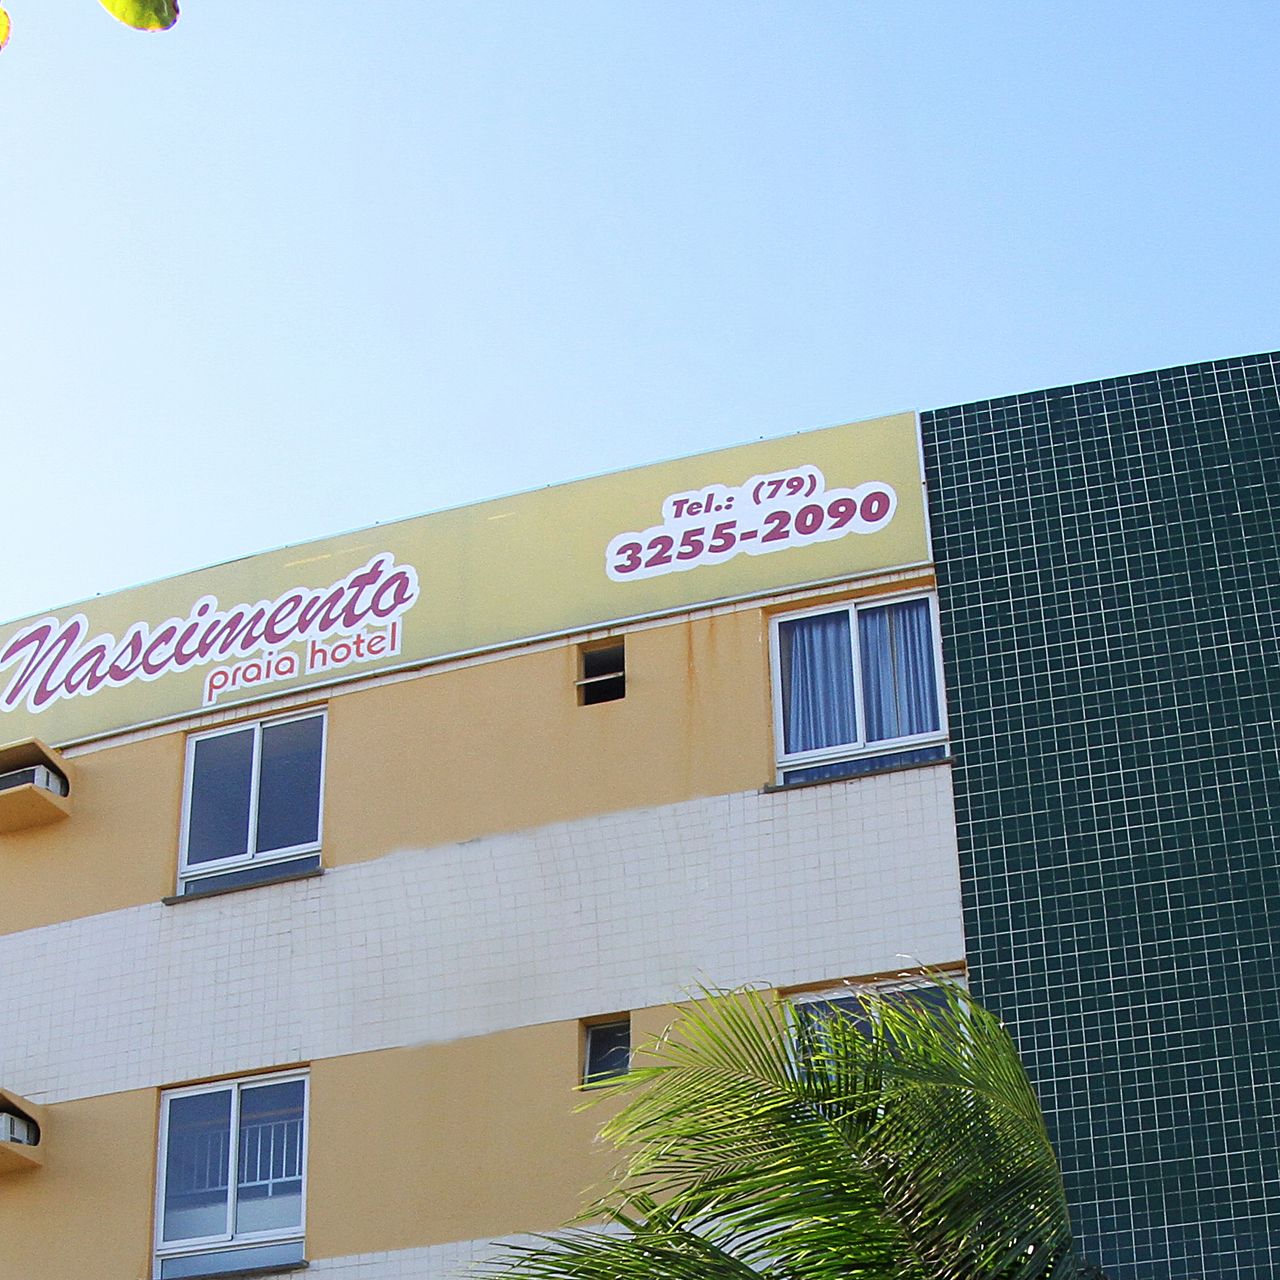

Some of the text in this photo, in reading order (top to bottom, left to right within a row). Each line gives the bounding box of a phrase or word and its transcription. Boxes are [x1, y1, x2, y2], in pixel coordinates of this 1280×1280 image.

[613, 491, 891, 574] 3255-2090
[672, 474, 818, 519] Tel.: (79)
[0, 559, 415, 706] Nascimento
[207, 621, 399, 702] praia hotel
